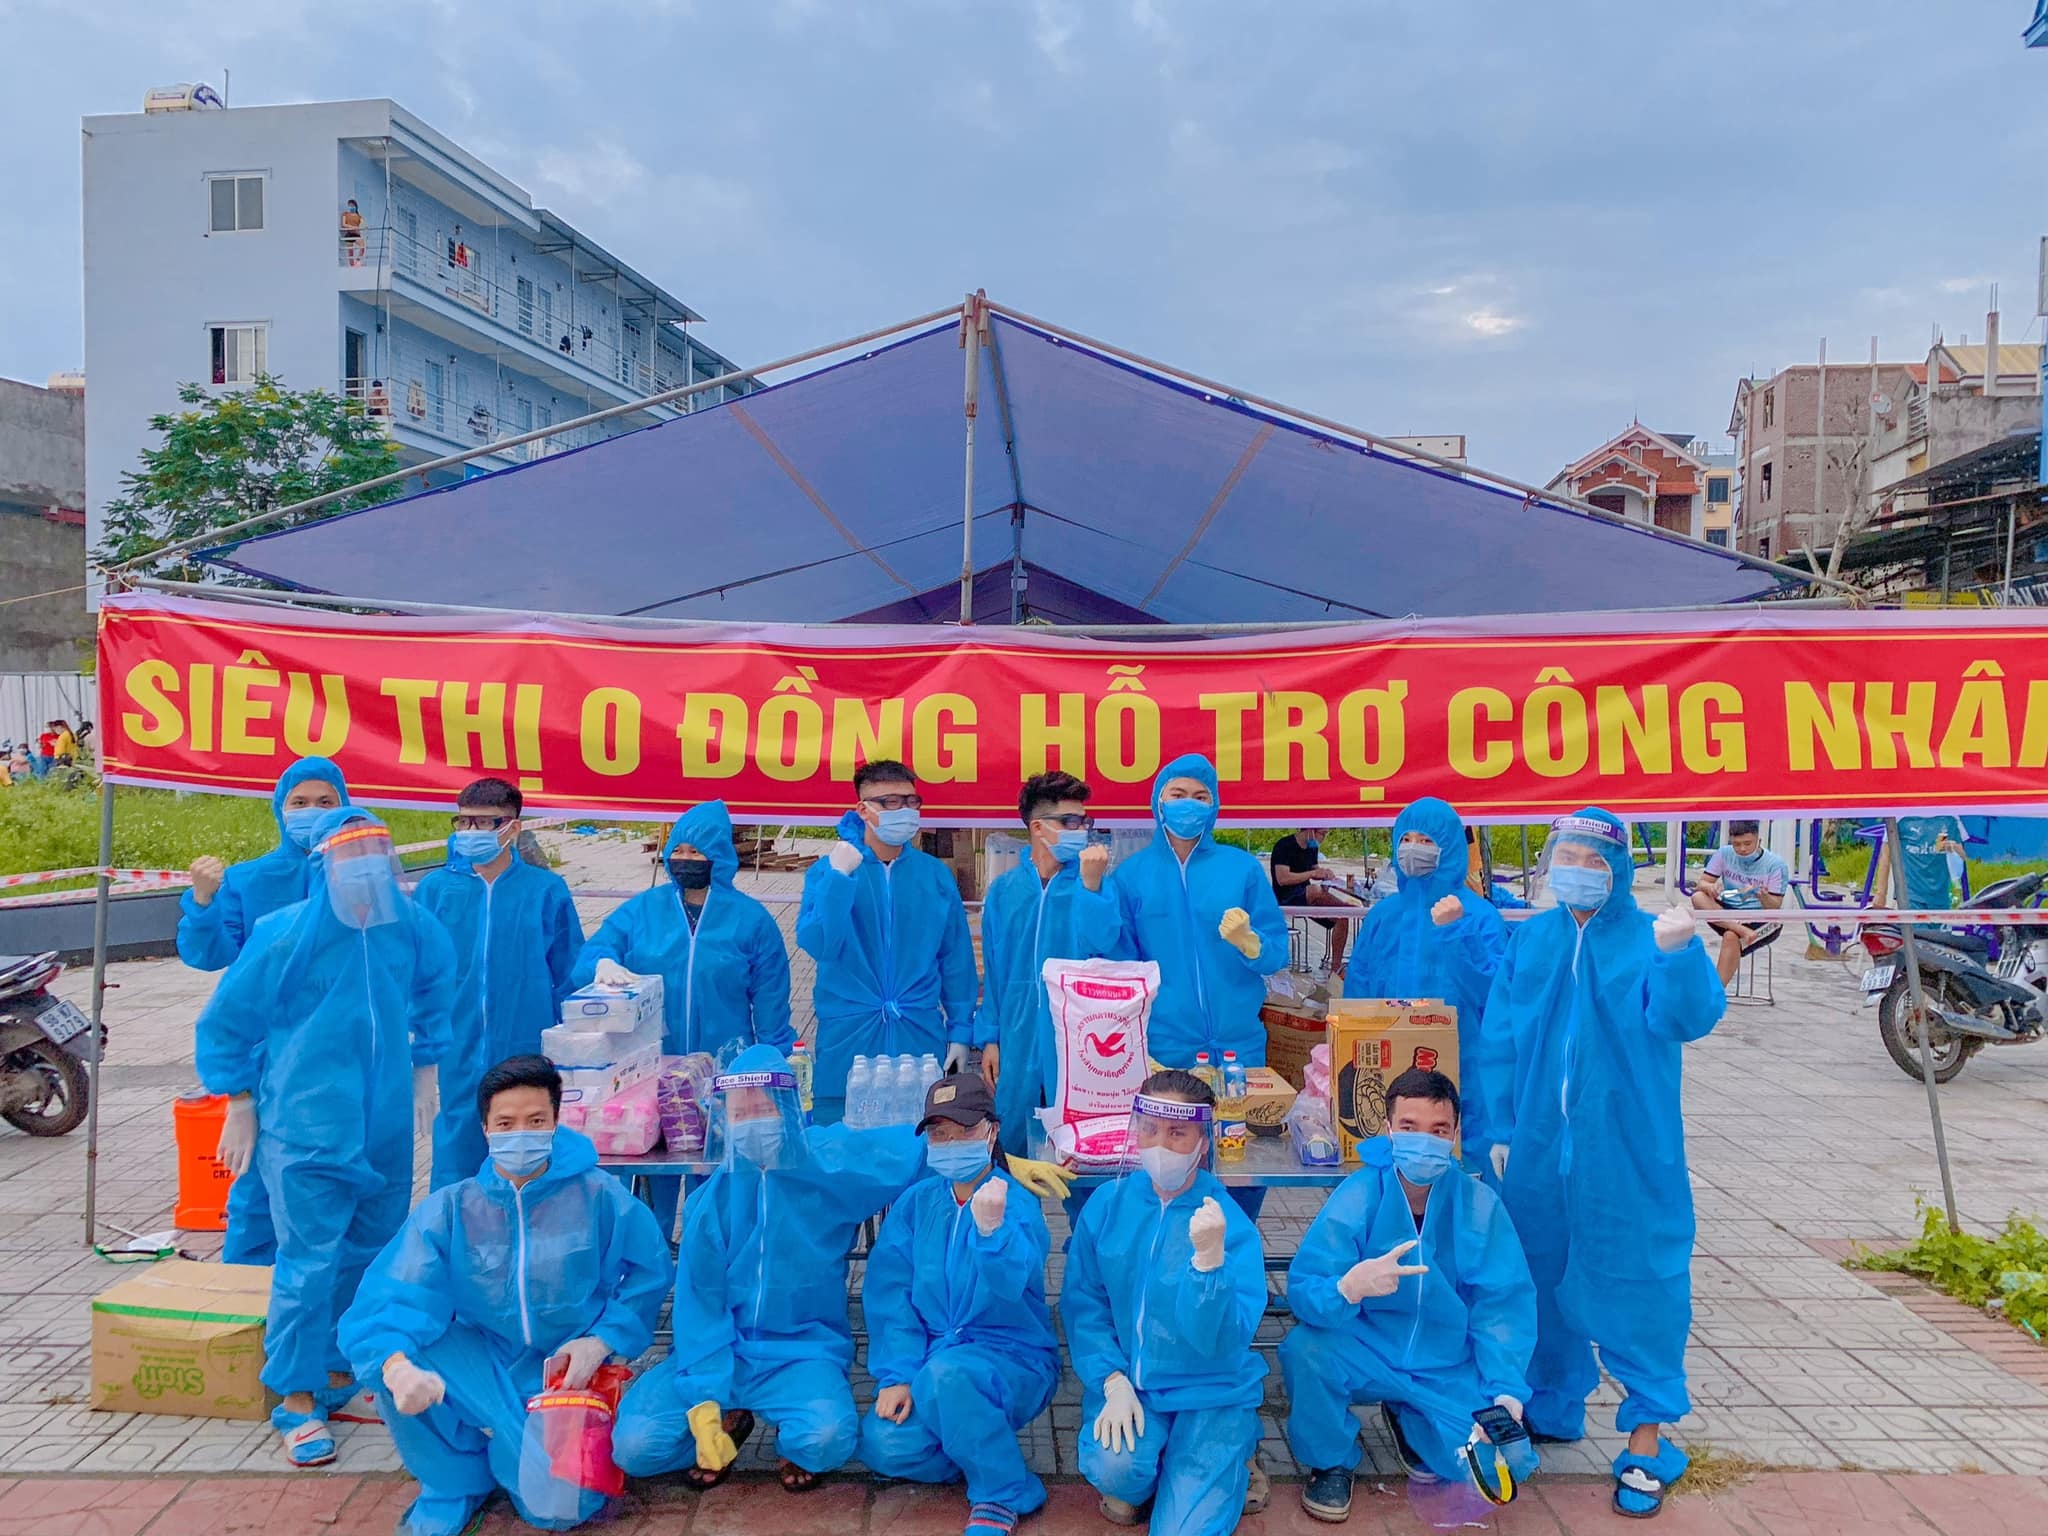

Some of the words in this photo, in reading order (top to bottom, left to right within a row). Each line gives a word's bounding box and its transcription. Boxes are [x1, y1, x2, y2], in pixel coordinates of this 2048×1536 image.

[122, 650, 349, 758] SIÊU
[381, 677, 543, 791] THỊ
[676, 666, 978, 783] ĐỒNG
[1020, 664, 1160, 783] HỖ
[1199, 680, 1408, 801] TRỢ
[1447, 666, 1748, 779] CÔNG
[738, 1074, 770, 1083] Shield
[1163, 1105, 1195, 1116] Shield
[213, 1169, 231, 1179] CR7
